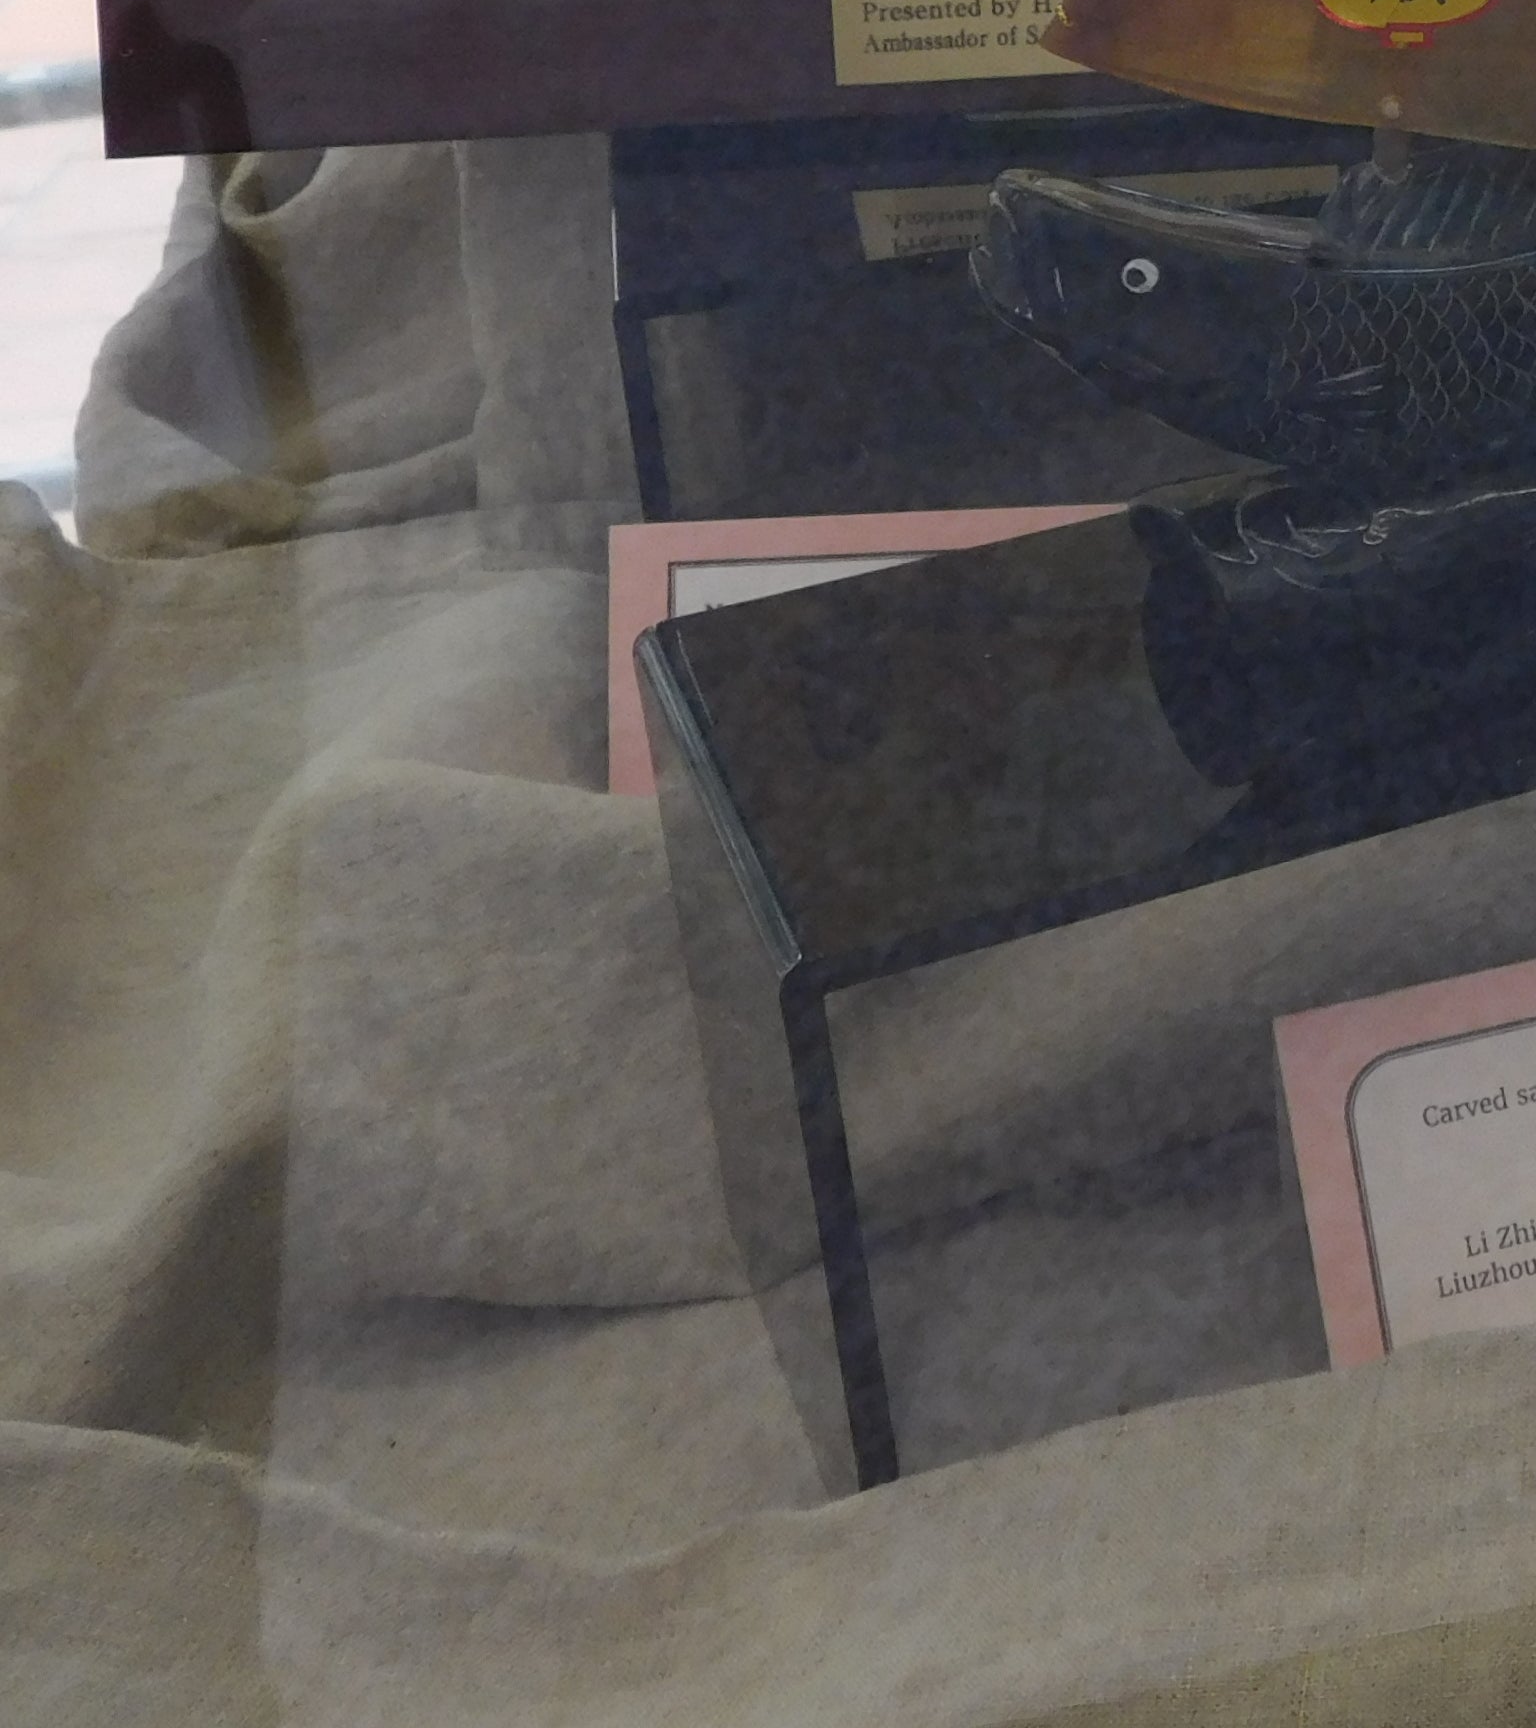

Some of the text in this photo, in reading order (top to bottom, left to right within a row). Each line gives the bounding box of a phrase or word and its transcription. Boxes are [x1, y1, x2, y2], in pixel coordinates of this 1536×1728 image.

[864, 31, 988, 54] Ambassador
[996, 26, 1018, 46] of
[1422, 1087, 1510, 1129] Carved
[1464, 1233, 1491, 1258] Li
